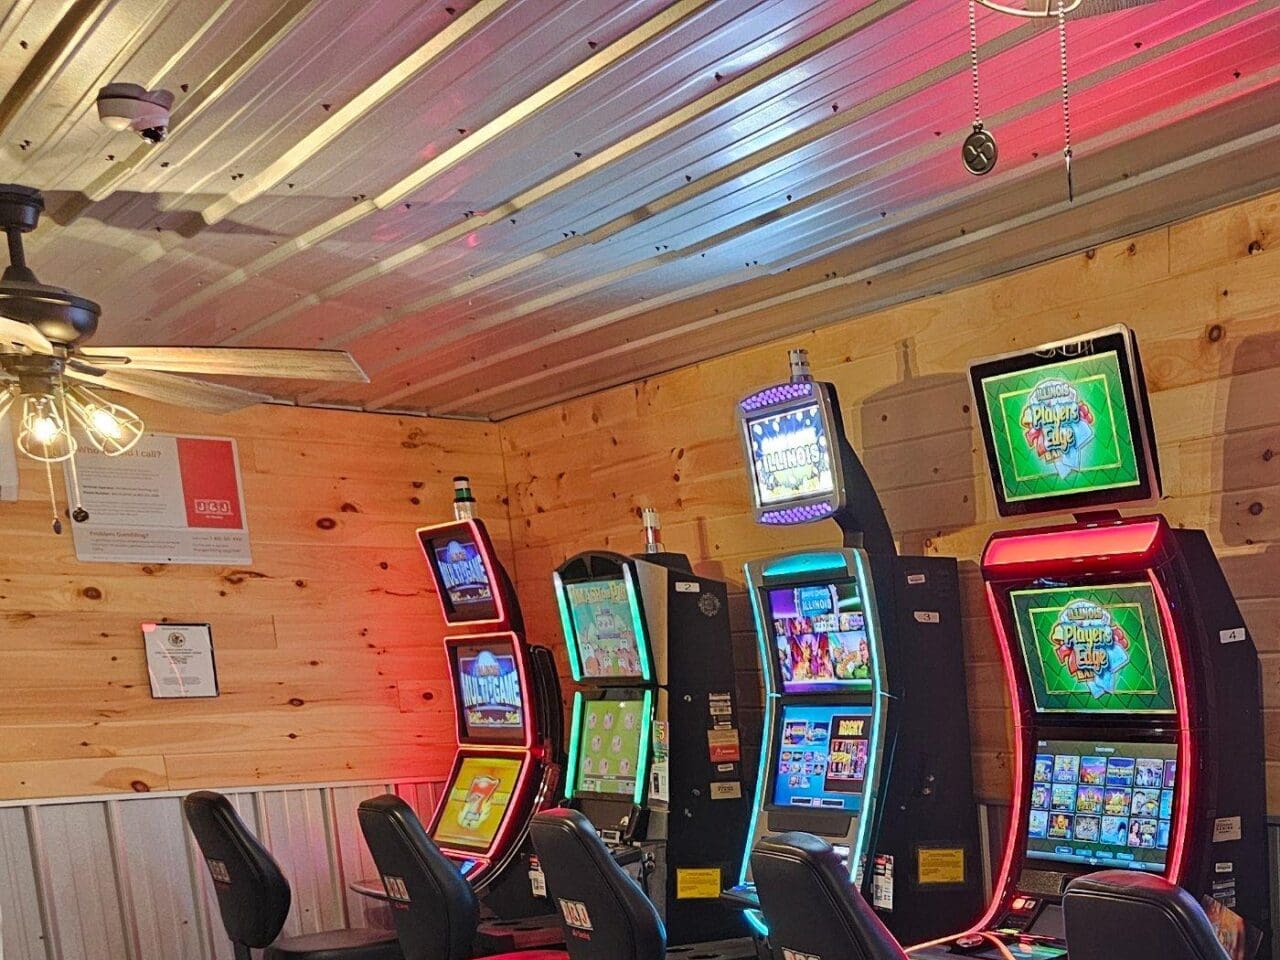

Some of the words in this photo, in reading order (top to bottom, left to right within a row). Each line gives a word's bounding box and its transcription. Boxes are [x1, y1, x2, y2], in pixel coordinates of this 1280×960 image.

[1036, 384, 1070, 401] ILLINOIS
[1032, 403, 1080, 428] Players
[1046, 426, 1075, 453] Edge
[763, 444, 820, 473] ILLINOIS
[1068, 607, 1103, 620] ILLINOIS
[1064, 625, 1113, 648] Players
[1077, 646, 1108, 672] Edge
